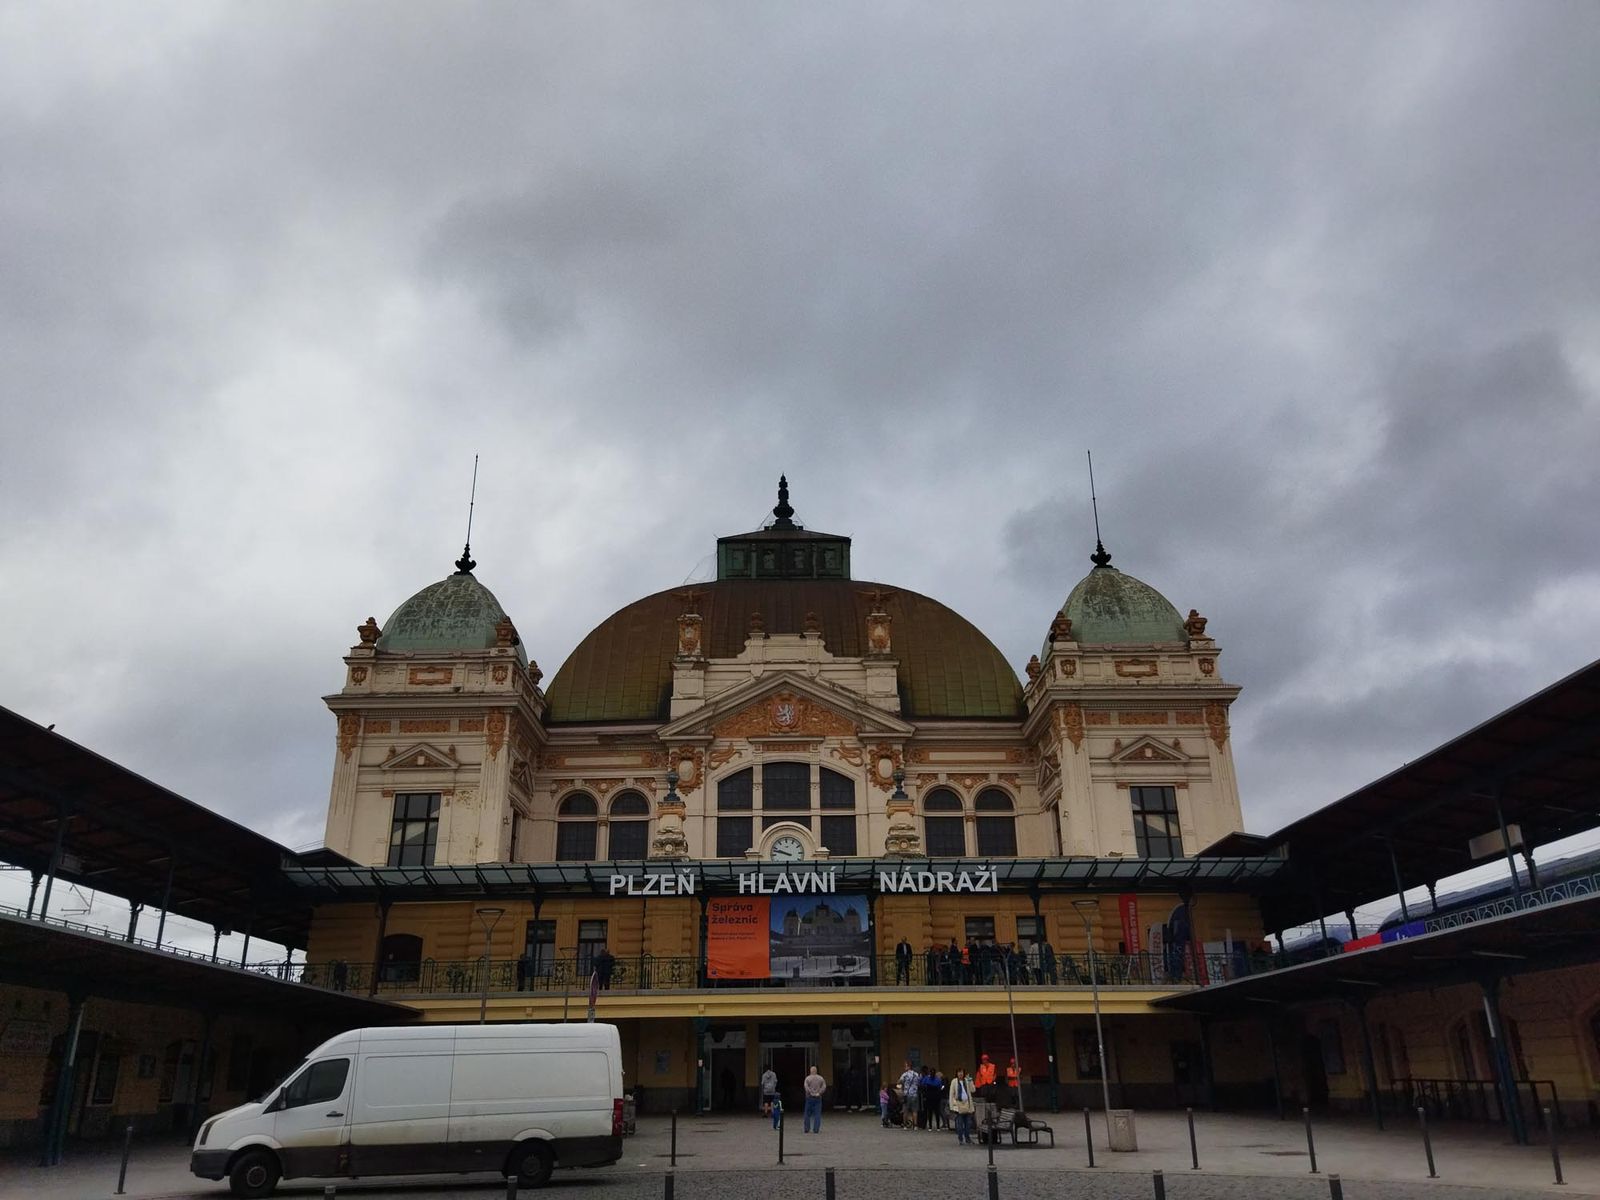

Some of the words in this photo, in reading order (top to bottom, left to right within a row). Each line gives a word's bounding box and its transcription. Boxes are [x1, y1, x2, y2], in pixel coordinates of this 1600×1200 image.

[609, 868, 695, 896] PLZEŇ
[739, 865, 837, 894] HLAVNÍ
[880, 865, 998, 893] NÁDRAŽÍ
[712, 902, 753, 914] Správa
[711, 914, 759, 925] železnic
